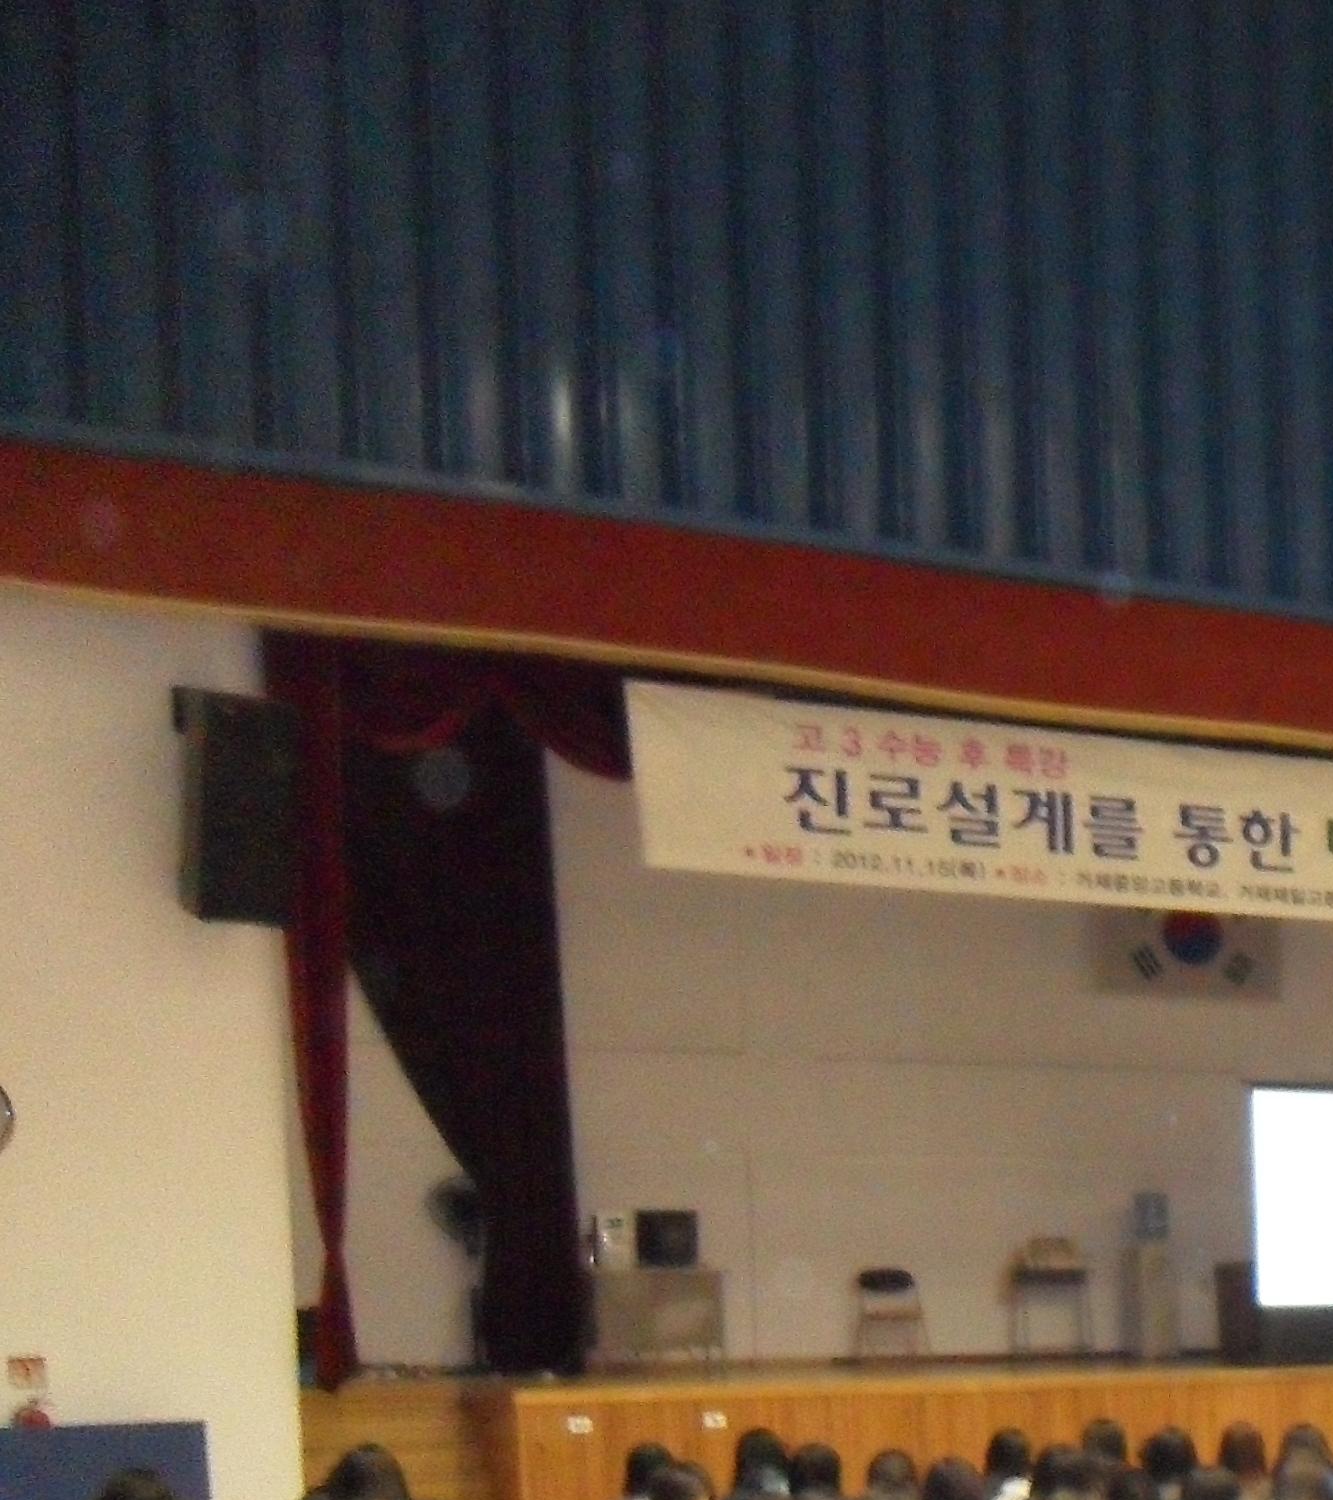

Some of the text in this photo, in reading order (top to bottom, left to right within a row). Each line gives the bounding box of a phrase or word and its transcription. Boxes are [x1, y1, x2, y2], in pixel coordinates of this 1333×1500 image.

[795, 723, 825, 753] 고
[841, 725, 862, 758] 3
[876, 730, 942, 769] 수능
[783, 764, 1145, 863] 진로설계를
[1173, 800, 1300, 876] 통한
